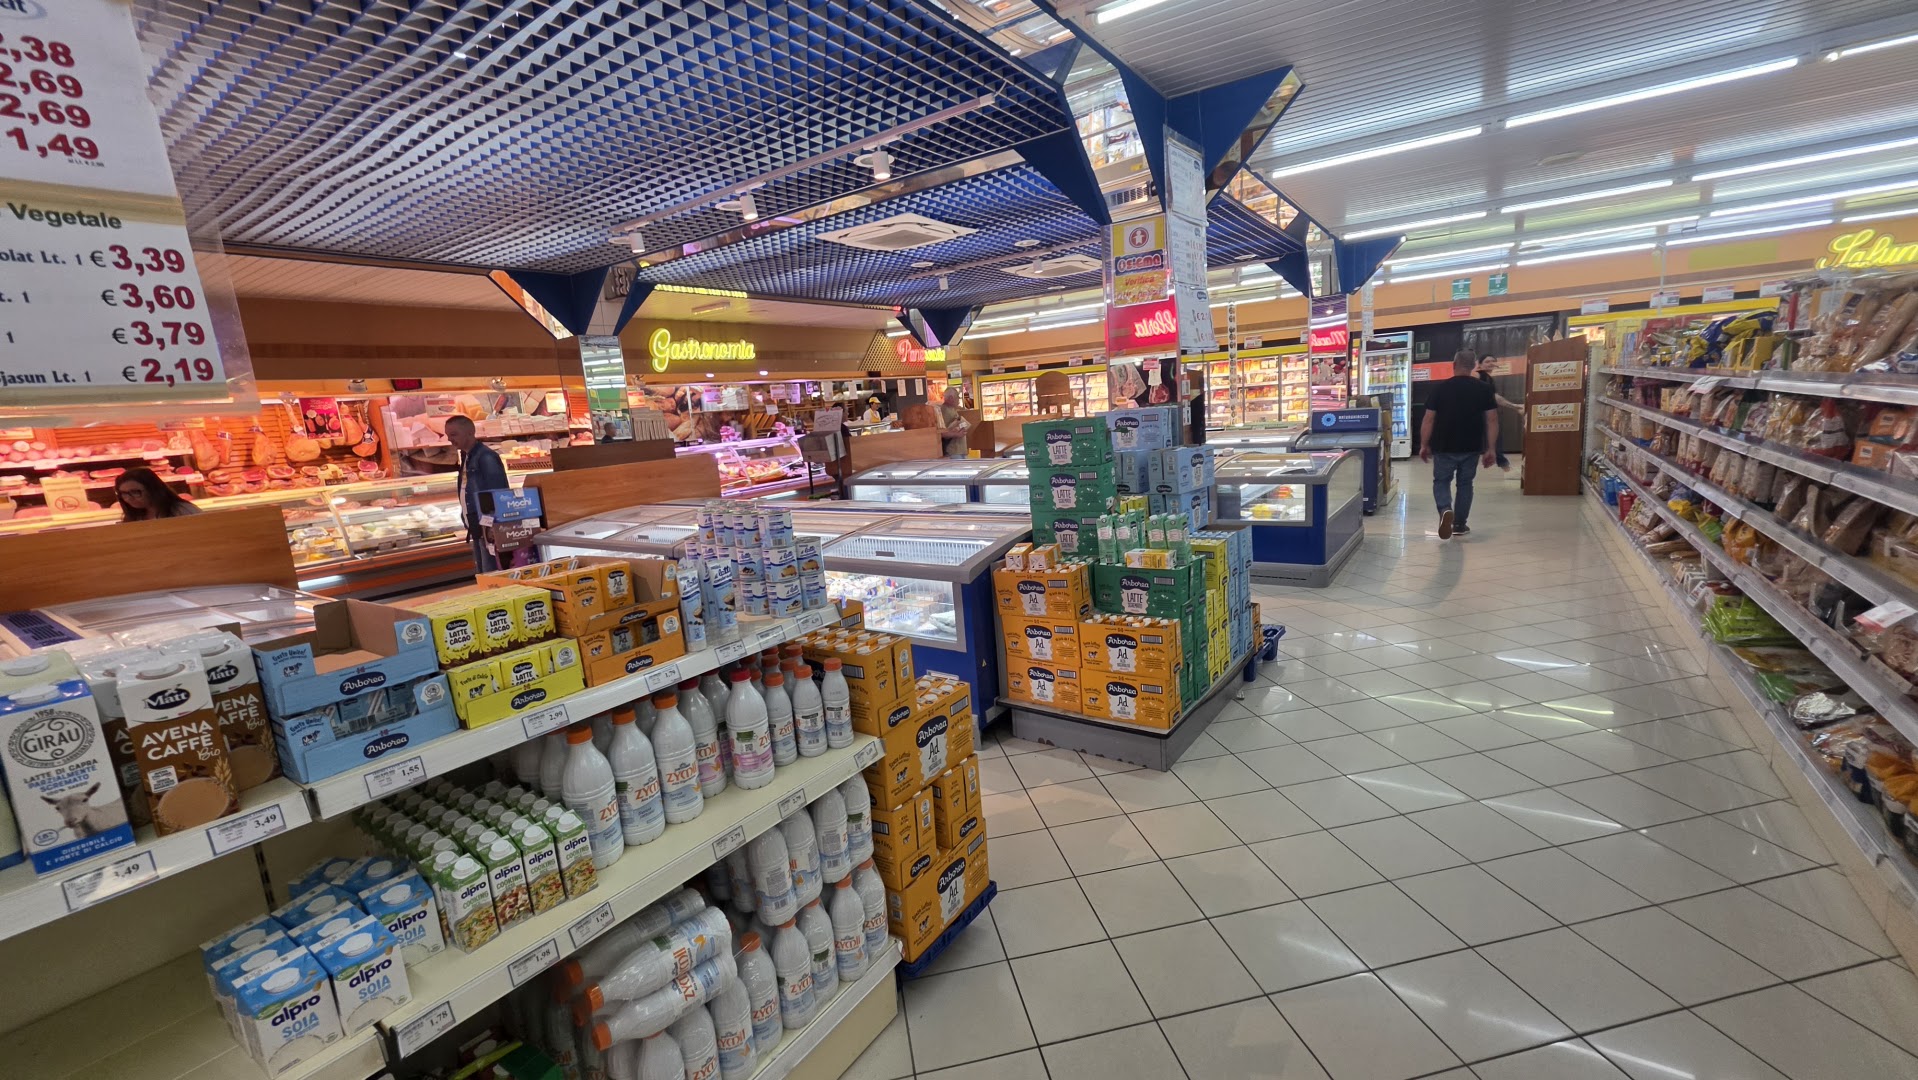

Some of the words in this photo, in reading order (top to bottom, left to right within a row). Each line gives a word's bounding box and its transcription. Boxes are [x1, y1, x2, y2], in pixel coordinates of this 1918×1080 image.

[0, 93, 91, 128] 2,69
[6, 127, 99, 160] 1,49
[7, 202, 122, 229] Vegetale
[41, 251, 66, 264] Lt.
[75, 254, 82, 265] 1
[22, 291, 30, 303] 1
[649, 328, 756, 372] Gastronomia
[52, 371, 76, 383] Lt.
[84, 371, 91, 382] 1
[1052, 445, 1067, 455] LATTE
[1056, 489, 1071, 499] LATTE
[507, 498, 532, 508] Mochi
[506, 528, 532, 538] Mochi
[1060, 534, 1074, 544] LATTE
[1121, 578, 1149, 588] Arborea
[1028, 594, 1038, 604] Ad
[1127, 592, 1143, 603] LATTE
[527, 609, 544, 618] LATTE
[527, 615, 547, 625] CACAO
[490, 618, 507, 628] LATTE
[490, 624, 511, 634] CACAO
[449, 629, 468, 638] LATTE
[449, 635, 471, 645] CACAO
[1035, 638, 1045, 648] Ad
[1107, 636, 1137, 647] Arborea
[1117, 649, 1128, 659] Ad
[342, 674, 385, 692] Arborea
[515, 671, 533, 681] LATTE
[1037, 681, 1046, 690] Ad
[1108, 684, 1137, 695] Arborea
[513, 690, 545, 706] Arborea
[1117, 696, 1128, 707] Ad
[35, 709, 55, 718] 1958
[549, 710, 563, 721] 2,99
[246, 718, 265, 730] Bio
[141, 720, 213, 748] AVENA
[918, 720, 947, 743] Arborea
[23, 727, 81, 753] GIRAU
[147, 732, 213, 760] CAFFÈ
[366, 735, 408, 753] Arborea
[197, 747, 221, 761] Bio
[928, 738, 939, 760] Ad
[23, 772, 51, 784] LATTE
[69, 759, 98, 771] CAPRA
[27, 765, 98, 789] PARZIALMENTE
[402, 765, 419, 776] 1,55
[40, 774, 89, 792] SCREMATO
[254, 814, 277, 829] 3,49
[55, 852, 81, 863] FONTE
[95, 836, 123, 849] CALCIO
[564, 836, 587, 851] alpro
[529, 849, 553, 865] alpro
[495, 864, 520, 880] alpro
[938, 860, 965, 891] Arborea
[461, 882, 486, 899] alpro
[948, 880, 958, 903] Ad
[388, 910, 427, 933] alpro
[595, 910, 609, 923] 1,98
[397, 924, 426, 944] SOIA
[535, 950, 551, 962] 1,98
[349, 959, 392, 988] alpro
[358, 975, 391, 1000] SOIA
[272, 995, 320, 1026] alpro
[282, 1012, 319, 1038] SOIA
[430, 1010, 448, 1027] 1,78
